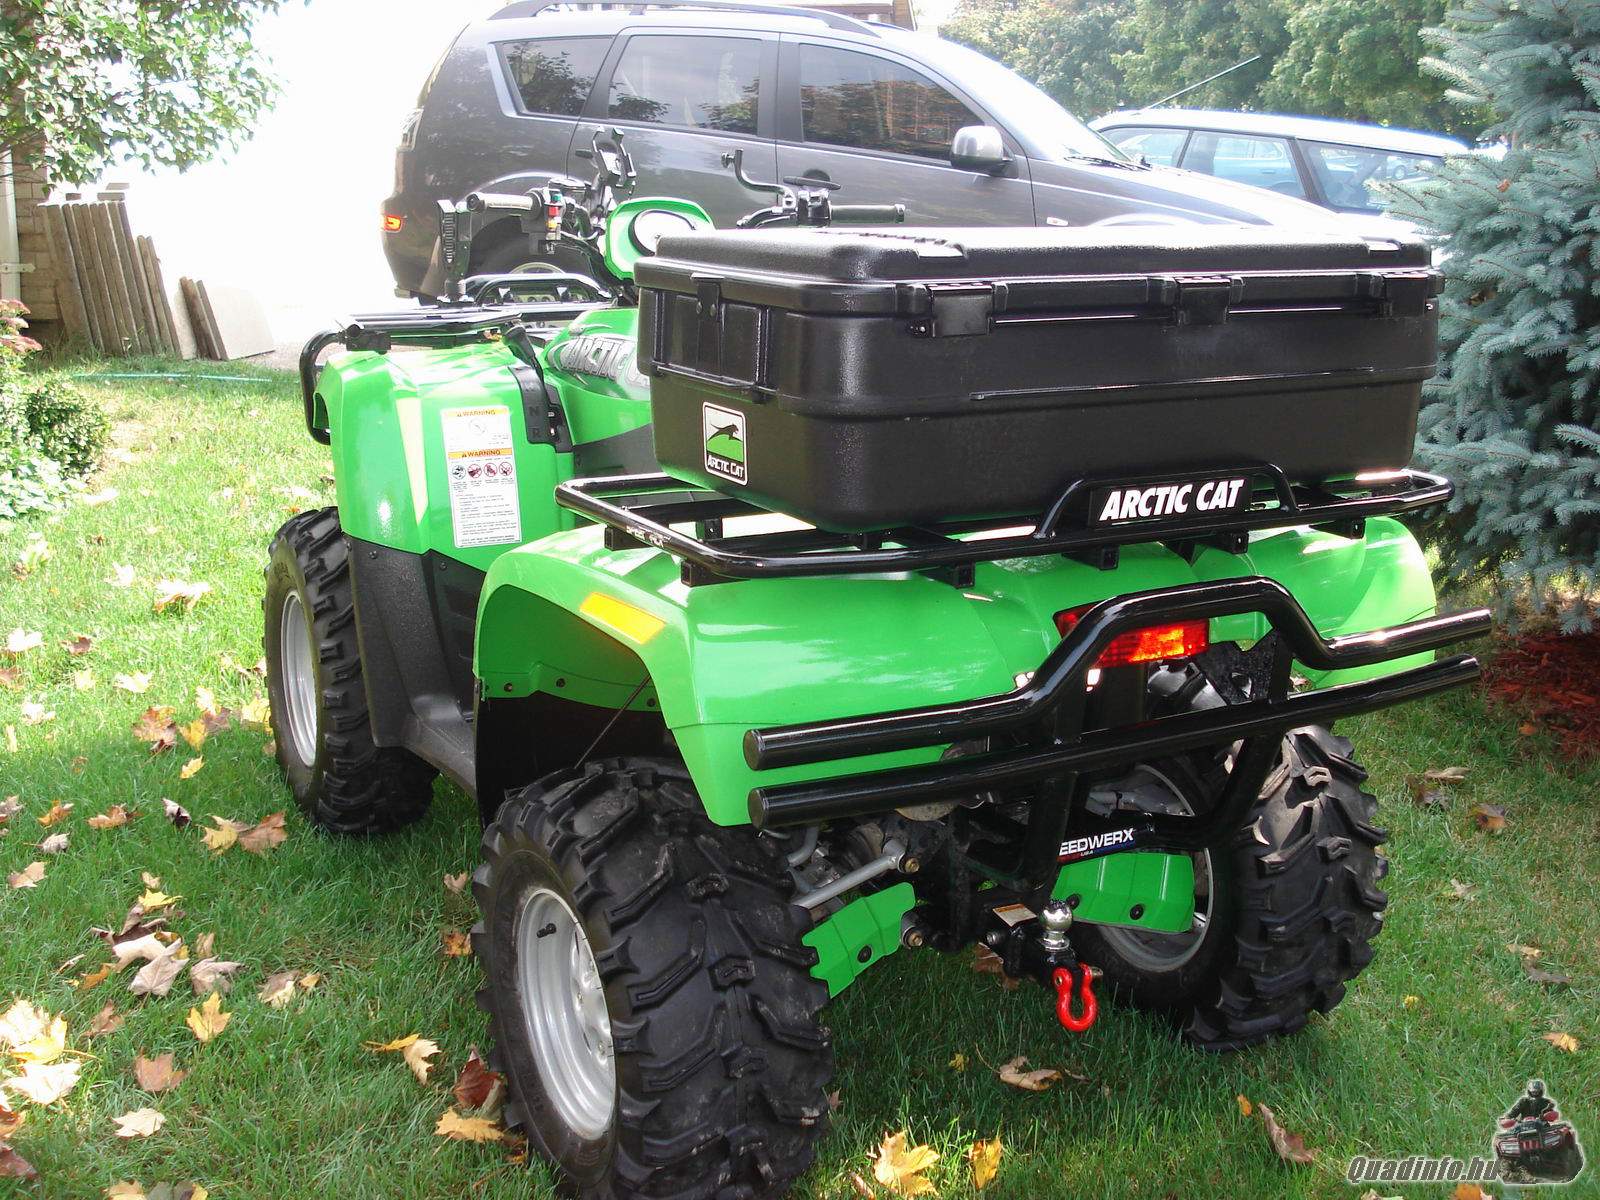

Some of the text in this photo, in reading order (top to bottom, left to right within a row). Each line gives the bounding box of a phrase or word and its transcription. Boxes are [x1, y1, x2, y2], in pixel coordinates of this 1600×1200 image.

[560, 337, 635, 379] ARCTIC
[463, 409, 496, 417] WARNING
[467, 449, 501, 457] WARNING
[707, 454, 744, 478] ARCTIC CAT
[1099, 479, 1245, 521] ARCTIC CAT
[1059, 827, 1134, 856] EEDWERX
[1080, 849, 1094, 857] USA
